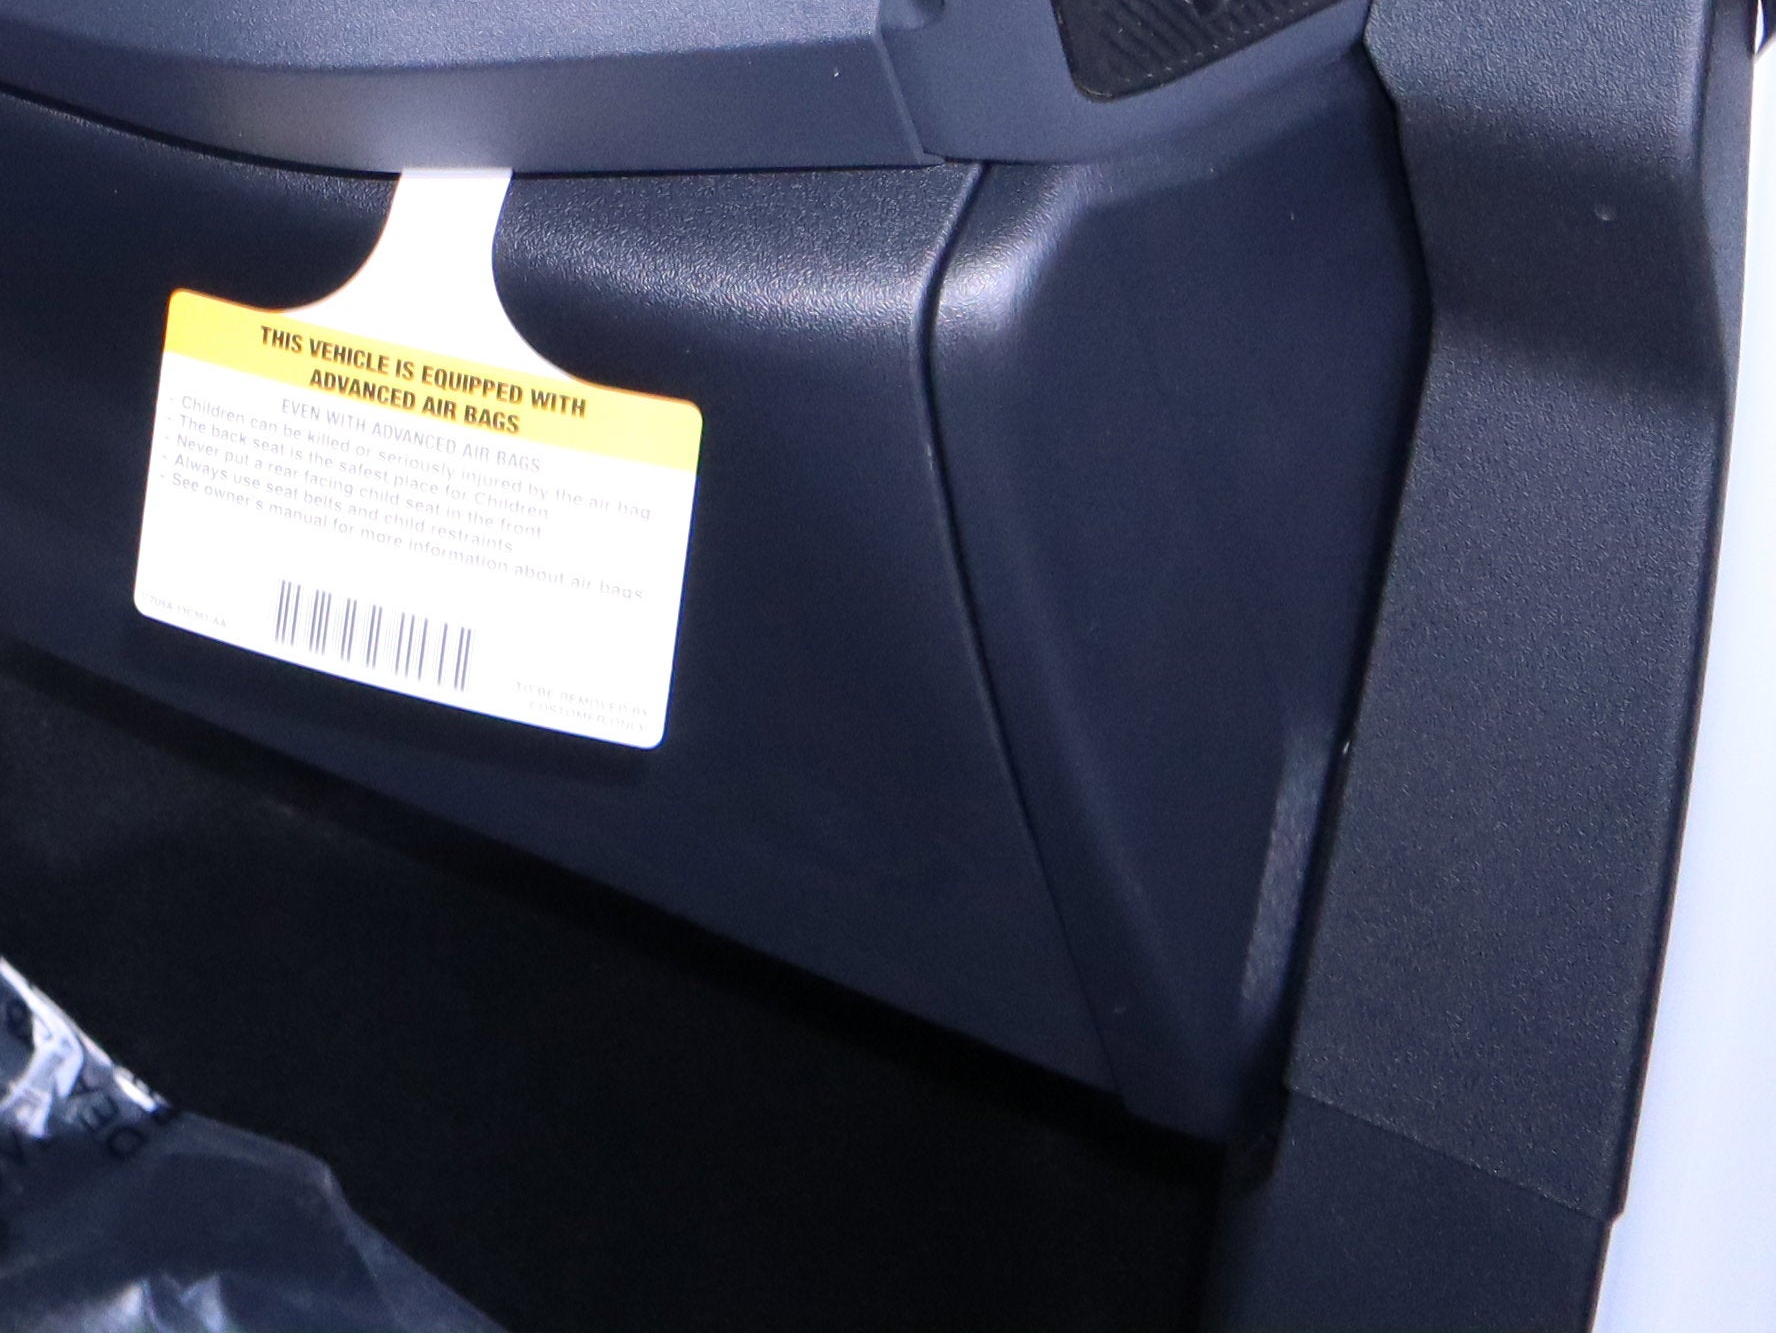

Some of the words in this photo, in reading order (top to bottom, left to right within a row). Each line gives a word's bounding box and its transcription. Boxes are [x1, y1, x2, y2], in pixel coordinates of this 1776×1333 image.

[261, 325, 302, 354] THIS
[309, 338, 390, 374] VEHICLE
[396, 359, 414, 382] IS
[422, 366, 523, 403] EQUIPPED
[531, 388, 586, 418] WITH
[309, 369, 415, 411] ADVANCED
[422, 395, 456, 420] AIR
[464, 405, 520, 434] BAGS
[177, 433, 219, 457] Never
[225, 449, 249, 468] put
[254, 459, 263, 471] a
[268, 462, 299, 479] rear
[304, 470, 354, 497] facing
[359, 485, 399, 506] child
[406, 497, 440, 517] seat
[447, 507, 461, 521] in
[468, 511, 494, 528] the
[501, 518, 541, 539] front
[180, 414, 206, 433] The
[211, 424, 246, 446] back
[253, 438, 284, 455] seat
[290, 446, 303, 461] is
[309, 448, 334, 468] the
[339, 461, 388, 485] safest
[394, 473, 438, 495] place
[445, 484, 466, 501] for
[475, 492, 549, 521] Children
[181, 395, 245, 425] Children
[251, 416, 278, 433] can
[284, 424, 301, 440] be
[308, 429, 350, 453] killed
[355, 445, 372, 458] or
[378, 449, 455, 480] seriously
[462, 469, 521, 493] injured
[528, 482, 549, 501] by
[555, 488, 582, 506] the
[589, 497, 610, 511] air
[618, 501, 652, 521] bag
[281, 398, 320, 422] EVEN
[326, 411, 366, 433] WITH
[371, 421, 457, 455] ADVANCED
[462, 442, 489, 462] AIR
[497, 450, 540, 473] BAGS
[172, 472, 199, 492] See
[269, 500, 327, 528] manual
[333, 517, 354, 535] for
[361, 527, 403, 549] more
[409, 538, 508, 571] information
[514, 563, 564, 586] about
[571, 574, 591, 591] air
[600, 579, 643, 601] bags
[174, 453, 227, 481] Always
[233, 471, 261, 489] use
[266, 480, 299, 499] seat
[304, 489, 342, 512] belts
[348, 503, 378, 521] and
[384, 511, 425, 533] child
[431, 524, 513, 554] restraints
